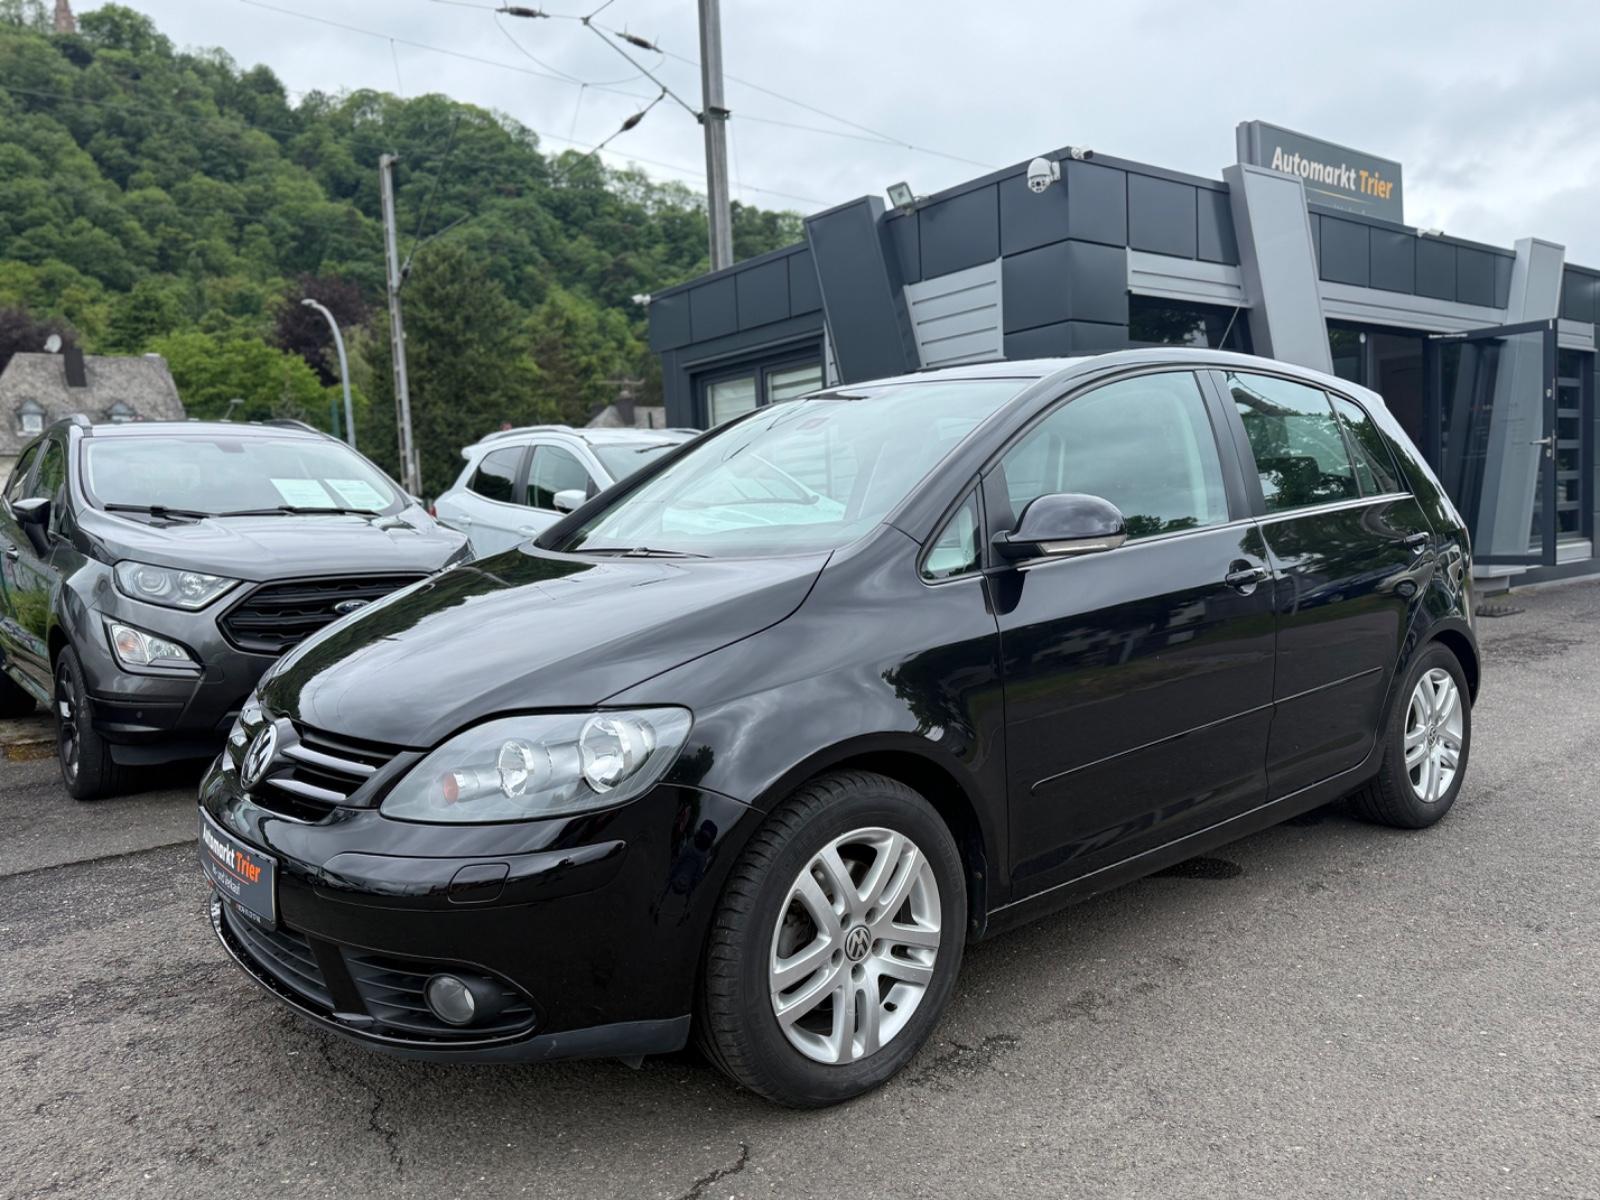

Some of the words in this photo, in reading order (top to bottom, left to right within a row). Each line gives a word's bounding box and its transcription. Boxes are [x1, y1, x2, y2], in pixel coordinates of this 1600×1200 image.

[1271, 146, 1356, 191] Automarkt
[1359, 169, 1393, 200] Trier
[235, 851, 261, 882] Trier
